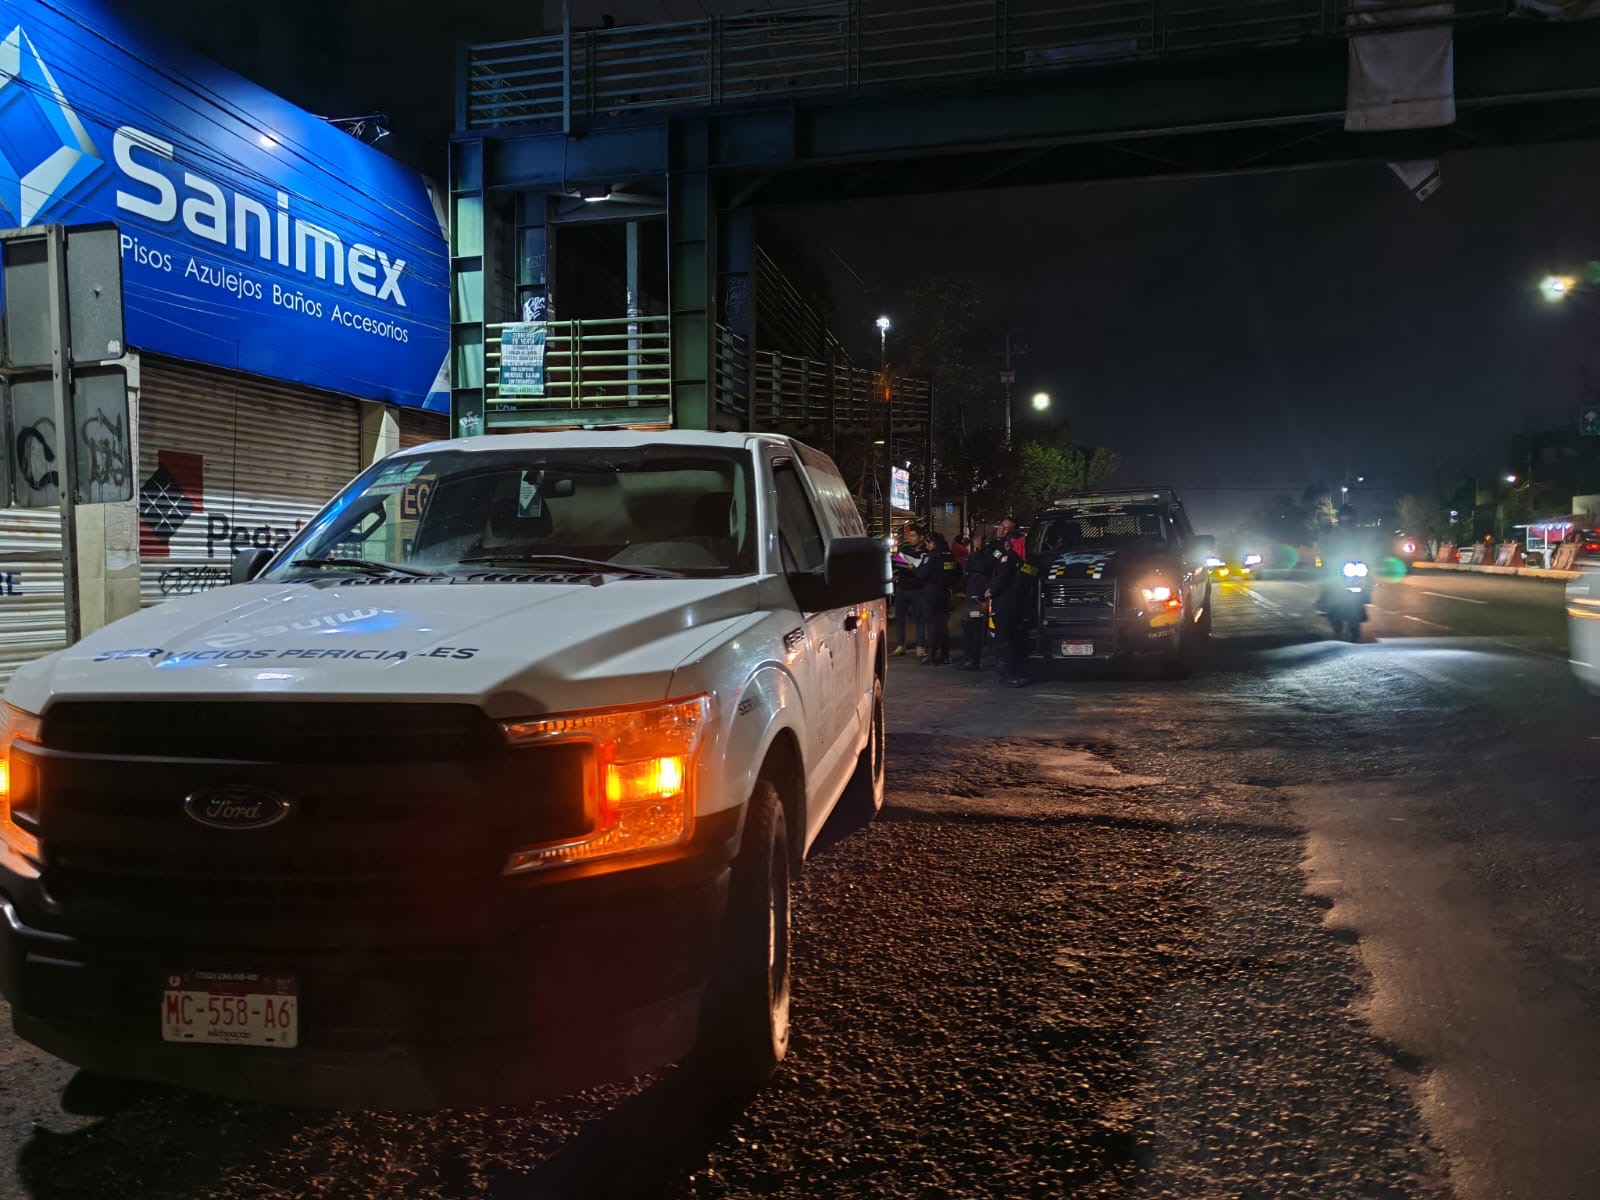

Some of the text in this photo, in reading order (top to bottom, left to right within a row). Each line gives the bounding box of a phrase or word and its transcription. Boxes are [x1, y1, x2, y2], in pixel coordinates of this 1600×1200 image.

[112, 125, 407, 307] Sanimex
[120, 233, 408, 343] Pisos Azulejos Baños Accesorios
[93, 648, 273, 662] SERVICIOS
[206, 795, 263, 820] Ford
[166, 994, 291, 1029] MC-558-A6
